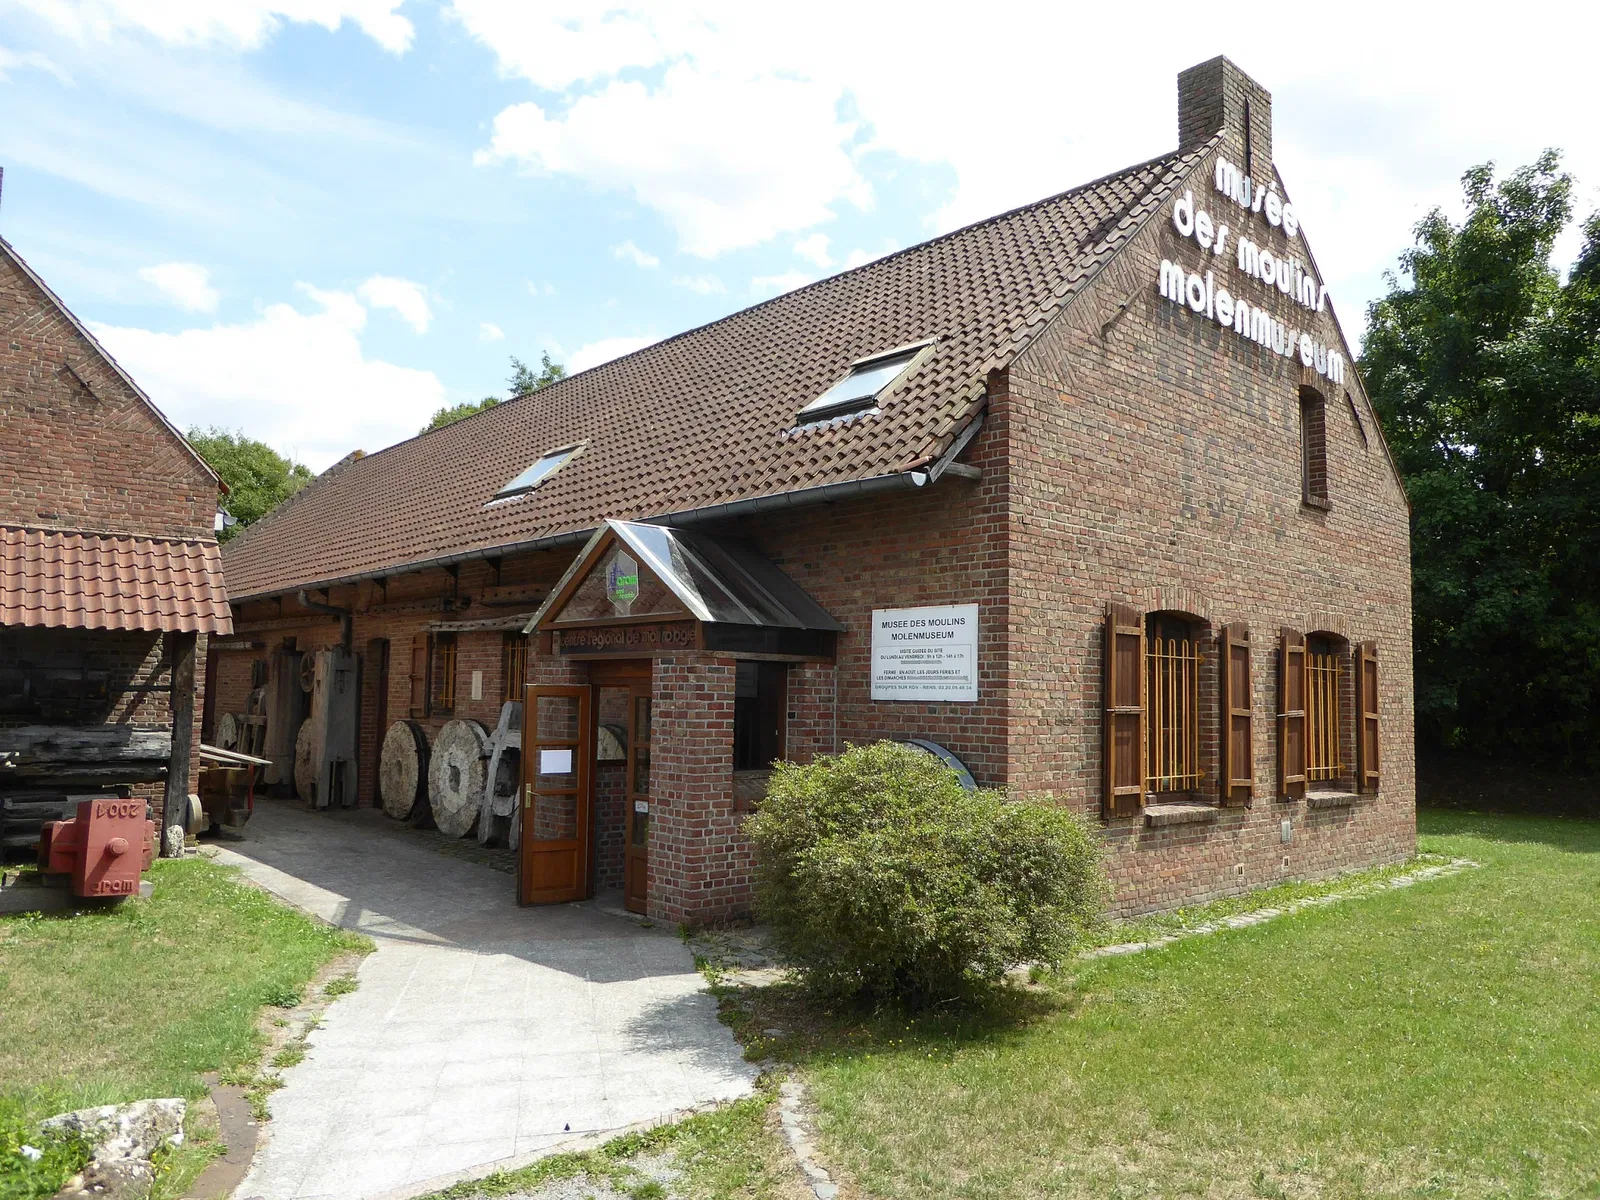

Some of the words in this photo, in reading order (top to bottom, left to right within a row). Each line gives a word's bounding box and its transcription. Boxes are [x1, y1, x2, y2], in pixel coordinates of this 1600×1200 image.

[1215, 156, 1298, 237] musée
[1174, 189, 1229, 255] des
[1238, 236, 1328, 312] moulins
[1159, 258, 1344, 384] molenmuseum
[881, 620, 908, 629] MUSEE
[910, 619, 926, 627] DES
[928, 617, 966, 627] MOULINS
[891, 630, 954, 641] MOLENMUSEUM
[96, 803, 140, 819] 2001
